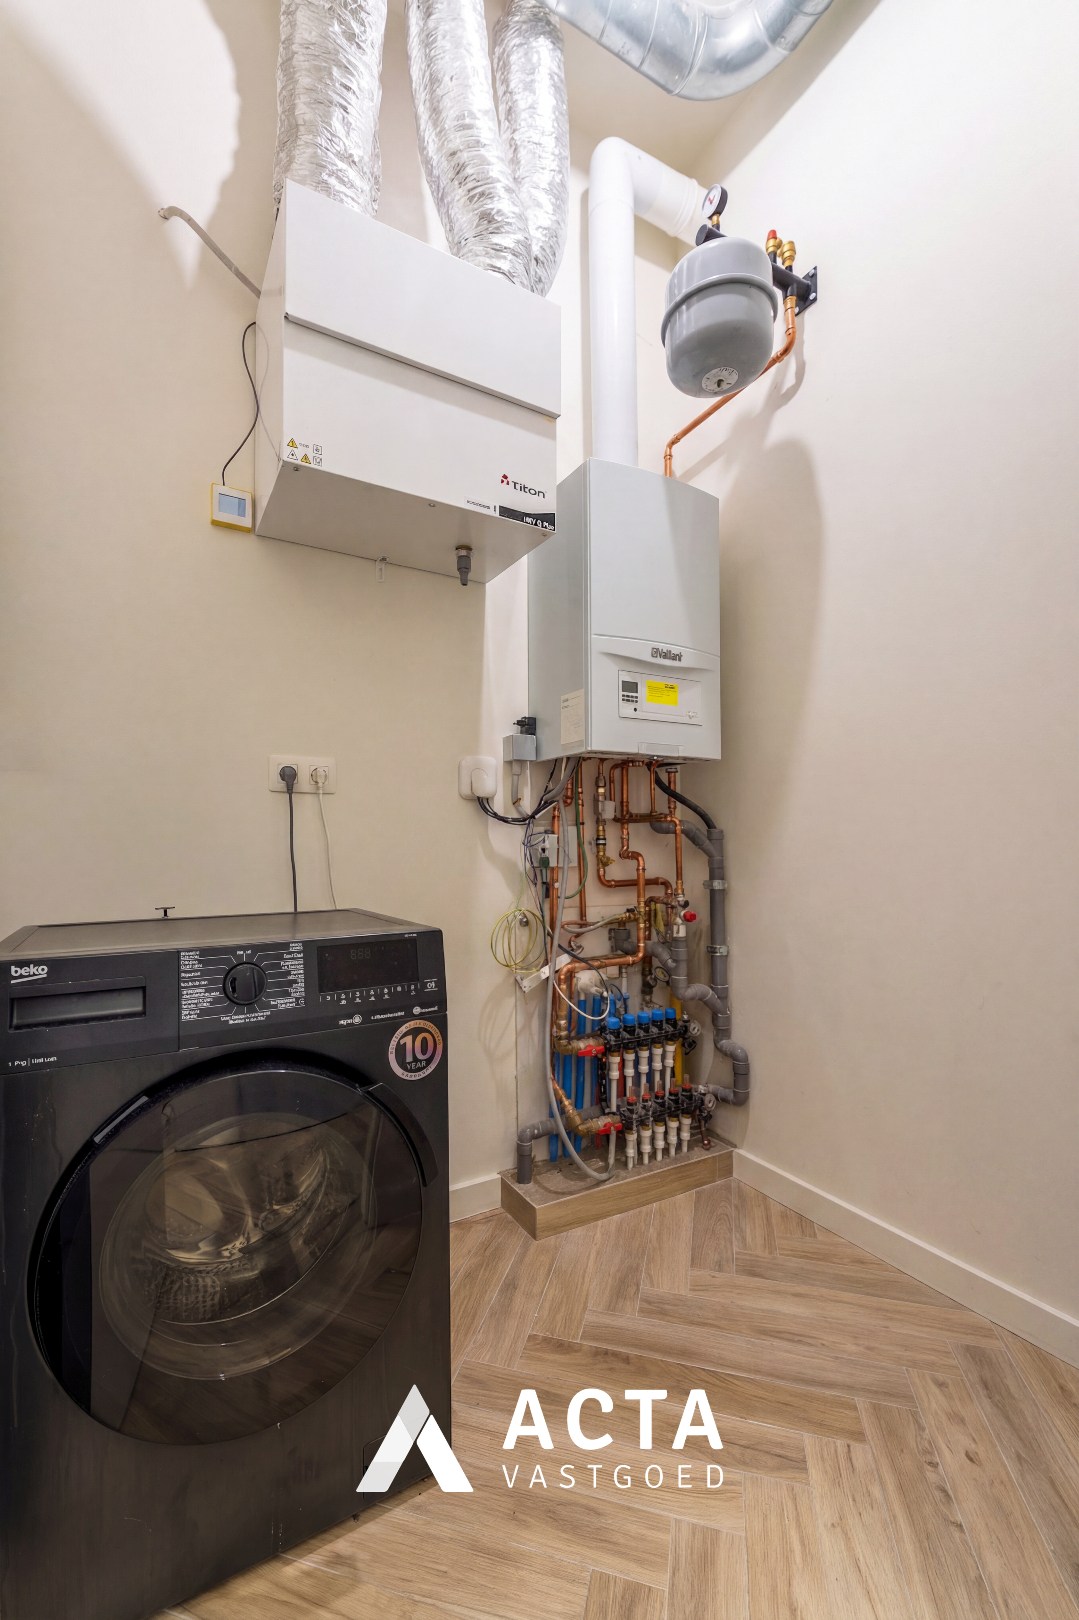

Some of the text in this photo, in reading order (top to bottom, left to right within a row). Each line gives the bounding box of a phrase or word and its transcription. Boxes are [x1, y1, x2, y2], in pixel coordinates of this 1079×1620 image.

[511, 480, 546, 499] Titon
[657, 648, 683, 663] Vaillant
[10, 964, 48, 976] beko
[399, 1032, 434, 1063] 10
[406, 1060, 427, 1071] YEAR
